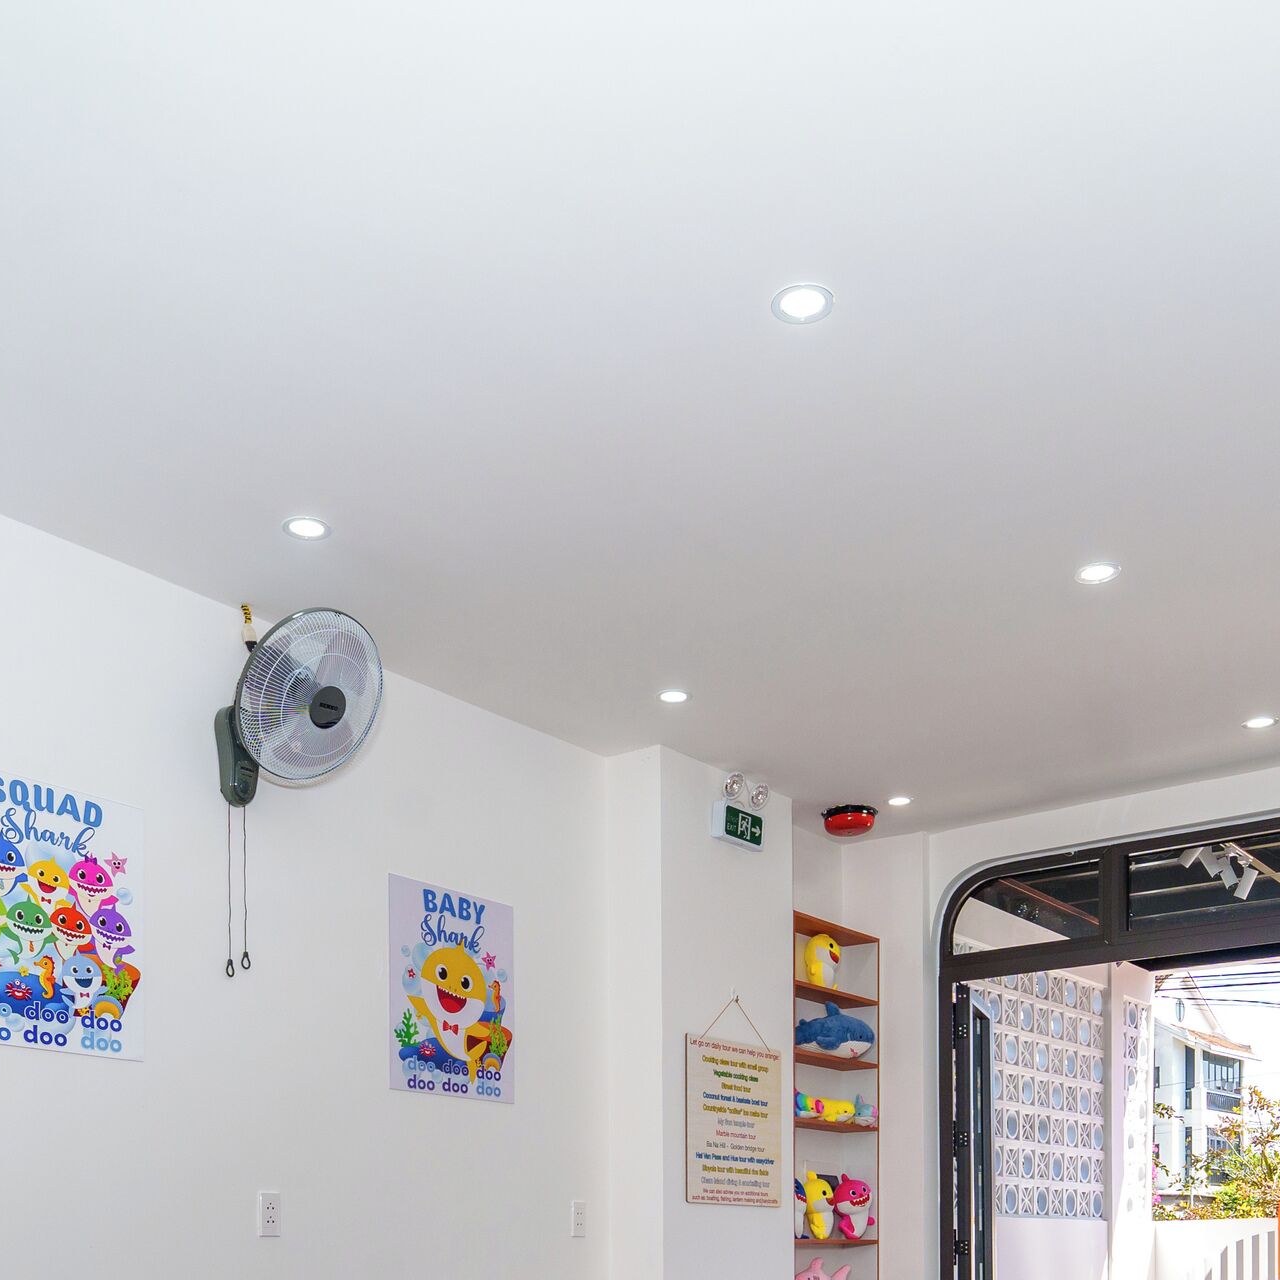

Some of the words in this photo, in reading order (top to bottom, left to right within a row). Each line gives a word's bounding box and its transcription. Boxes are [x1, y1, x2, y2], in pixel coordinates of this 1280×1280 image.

[0, 807, 96, 857] Shark
[423, 889, 485, 924] BABY
[421, 914, 485, 953] Shark
[24, 1002, 70, 1025] doo
[81, 1011, 122, 1033] doo
[24, 1025, 67, 1047] doo
[81, 1033, 122, 1052] doo
[698, 1040, 704, 1048] go
[711, 1043, 721, 1051] daily
[747, 1049, 755, 1057] help
[407, 1057, 435, 1072] doo
[443, 1060, 469, 1076] doo
[476, 1065, 501, 1081] doo
[407, 1075, 435, 1090] doo
[442, 1078, 468, 1093] doo
[476, 1083, 500, 1097] doo
[730, 1143, 744, 1151] Golden
[745, 1144, 757, 1153] bridge
[748, 1132, 756, 1140] tour
